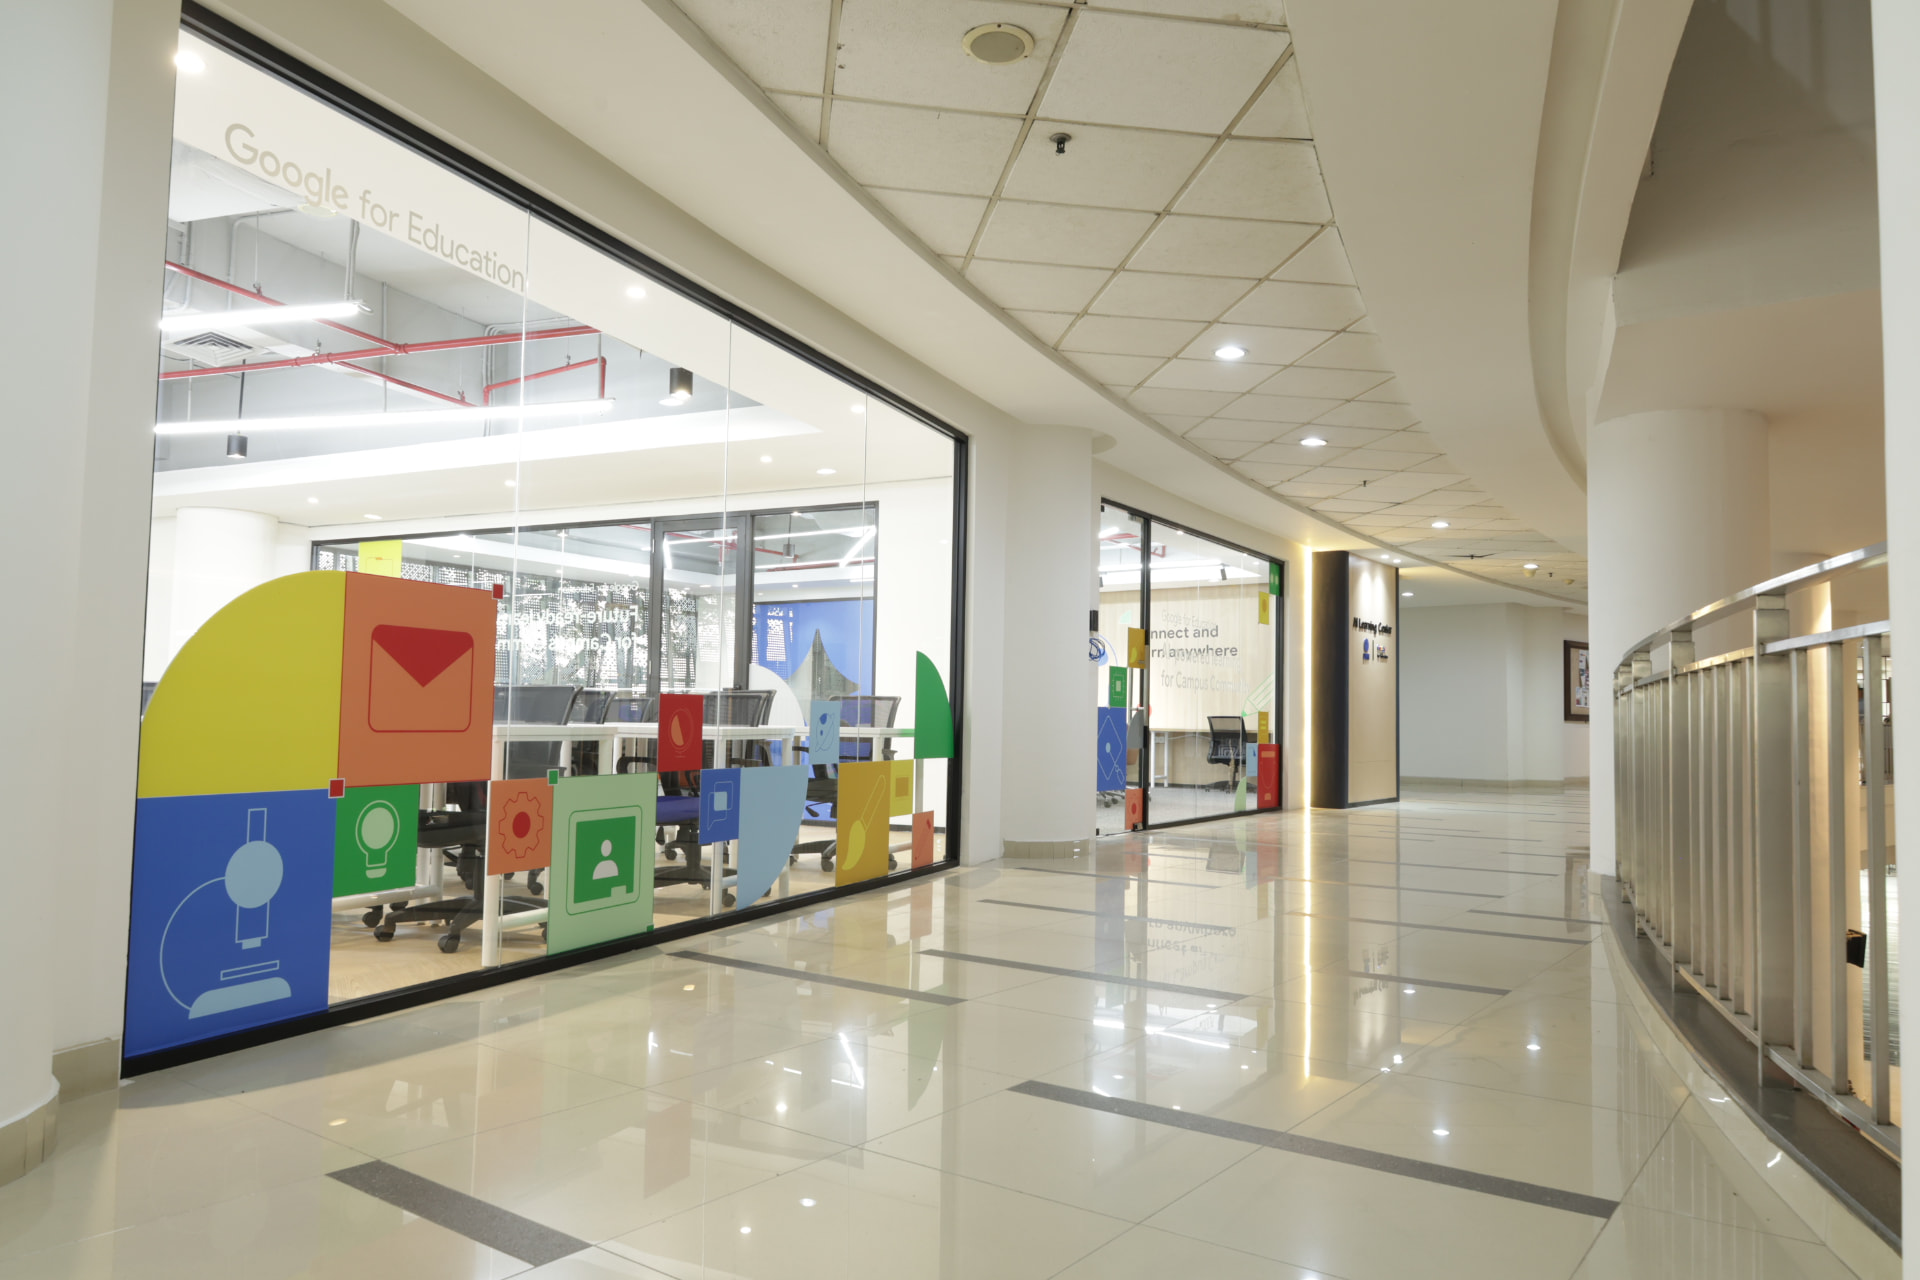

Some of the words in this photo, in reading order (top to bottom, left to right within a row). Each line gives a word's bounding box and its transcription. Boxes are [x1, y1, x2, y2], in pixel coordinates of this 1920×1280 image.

[224, 122, 349, 210] Google
[359, 189, 400, 232] for
[407, 210, 526, 293] Education
[1150, 627, 1189, 640] nnect
[1193, 625, 1219, 638] and
[1169, 644, 1238, 661] anywhere
[1175, 671, 1209, 695] Campus
